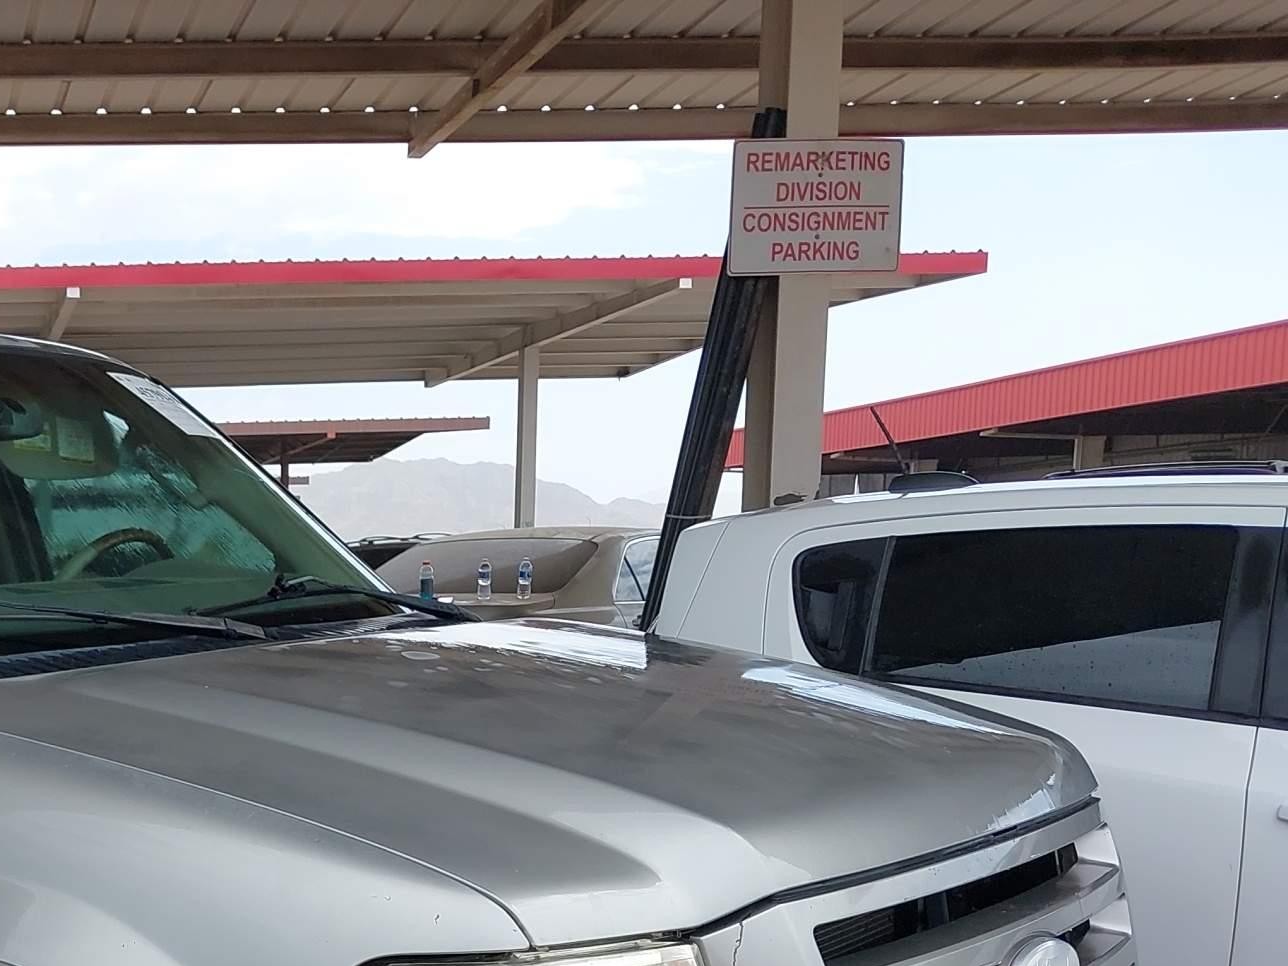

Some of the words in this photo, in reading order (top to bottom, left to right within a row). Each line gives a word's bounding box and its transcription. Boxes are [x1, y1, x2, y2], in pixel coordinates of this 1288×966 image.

[746, 151, 891, 172] REMARKETING
[775, 180, 861, 203] DIVISION
[743, 211, 889, 232] CONSIGNMENT
[770, 241, 860, 262] PARKING
